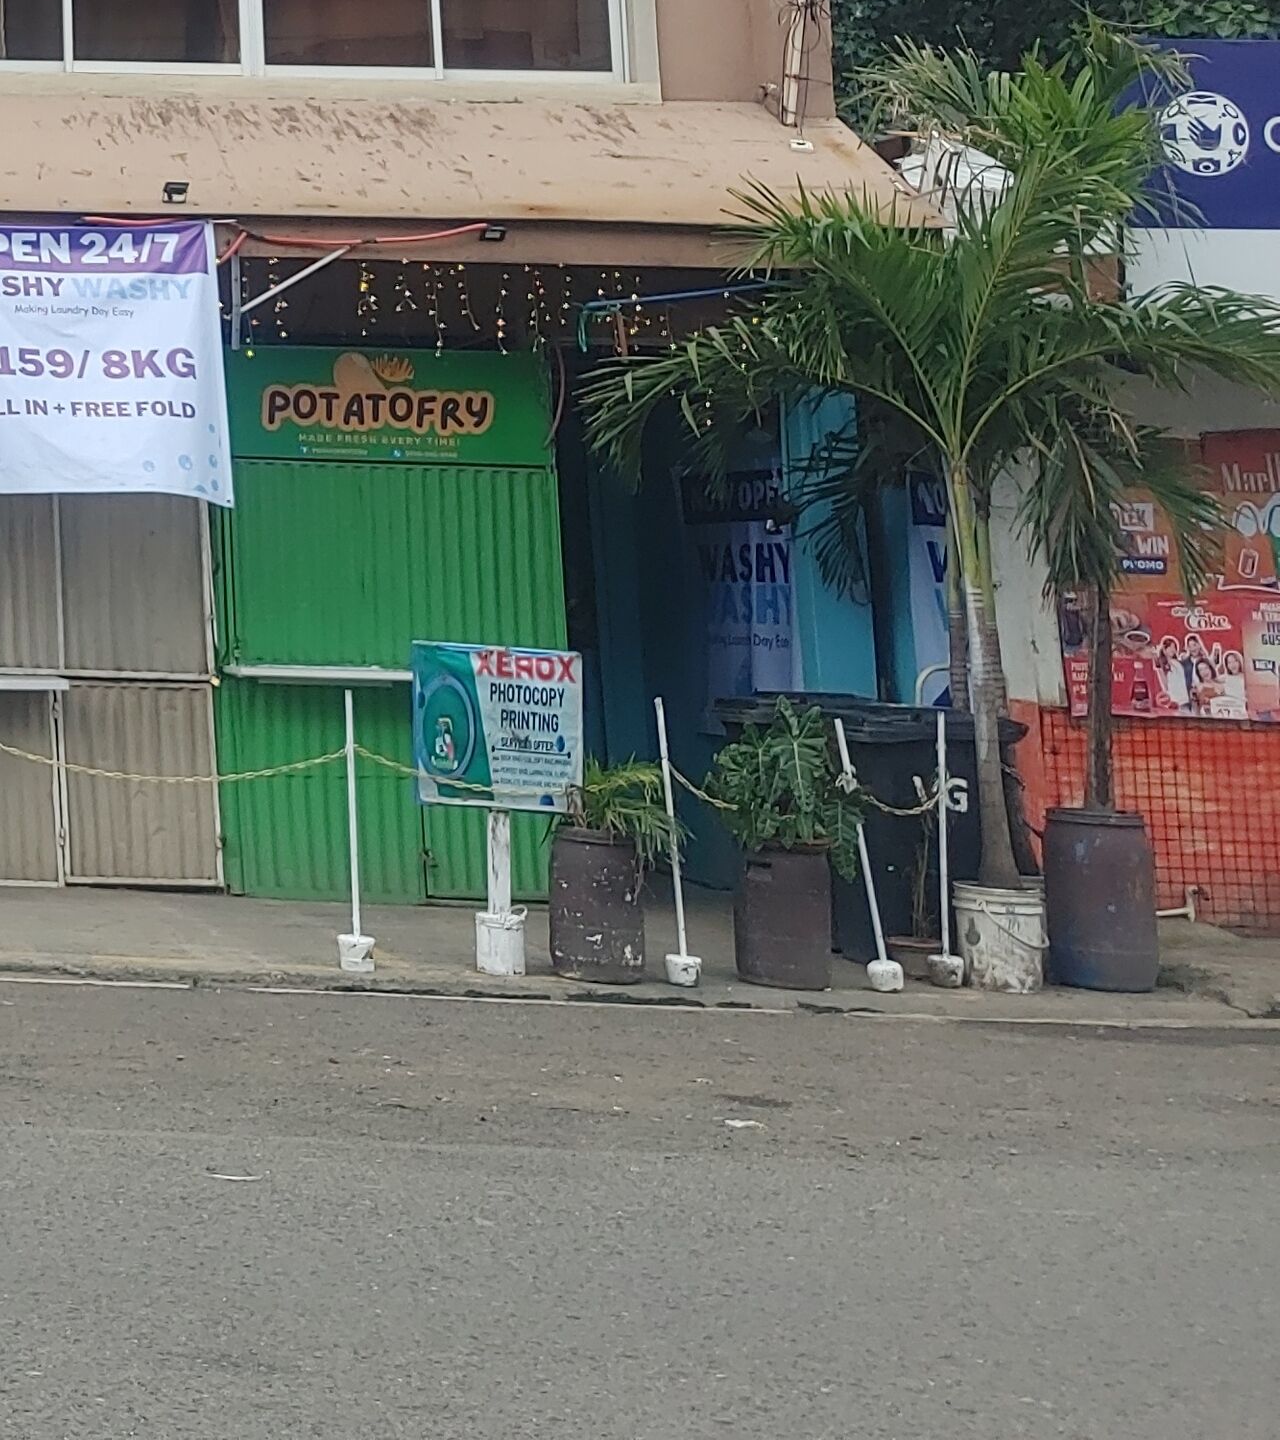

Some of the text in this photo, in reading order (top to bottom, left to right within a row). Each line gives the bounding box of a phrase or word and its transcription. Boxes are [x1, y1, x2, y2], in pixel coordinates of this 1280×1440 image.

[79, 232, 179, 264] 24/7
[71, 277, 192, 301] WASHY
[101, 348, 197, 380] 8KG
[25, 399, 48, 416] IN
[70, 401, 132, 418] FREE
[136, 401, 196, 419] FOLD
[267, 389, 489, 430] POTATOFRY
[1136, 535, 1169, 555] WIN
[708, 583, 791, 624] ASHY
[1186, 613, 1228, 629] Coke
[490, 683, 564, 707] PHOTOCOPY
[500, 709, 559, 733] PRINTING
